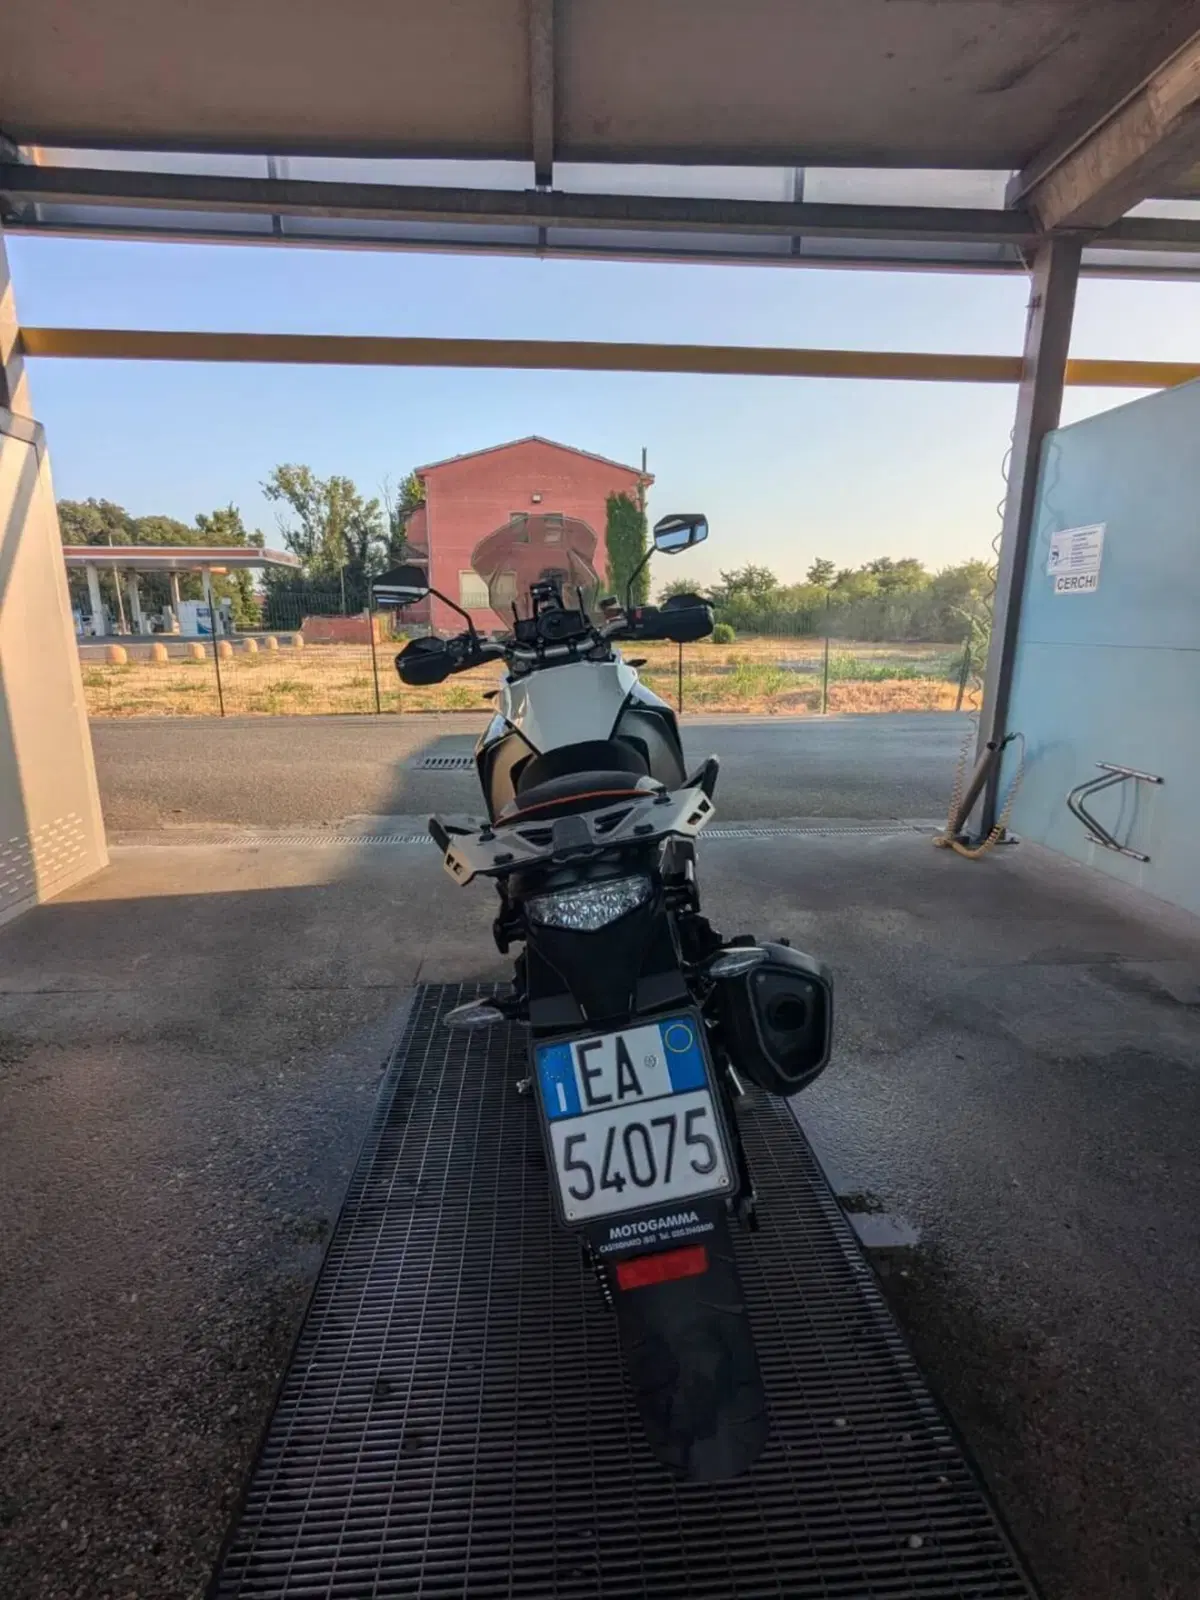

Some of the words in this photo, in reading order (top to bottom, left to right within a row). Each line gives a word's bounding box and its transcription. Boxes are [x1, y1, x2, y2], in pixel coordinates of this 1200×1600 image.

[1056, 575, 1097, 591] CERCHI
[576, 1036, 643, 1106] EA
[563, 1107, 717, 1200] 54075
[609, 1211, 699, 1240] MOTOGAMMA
